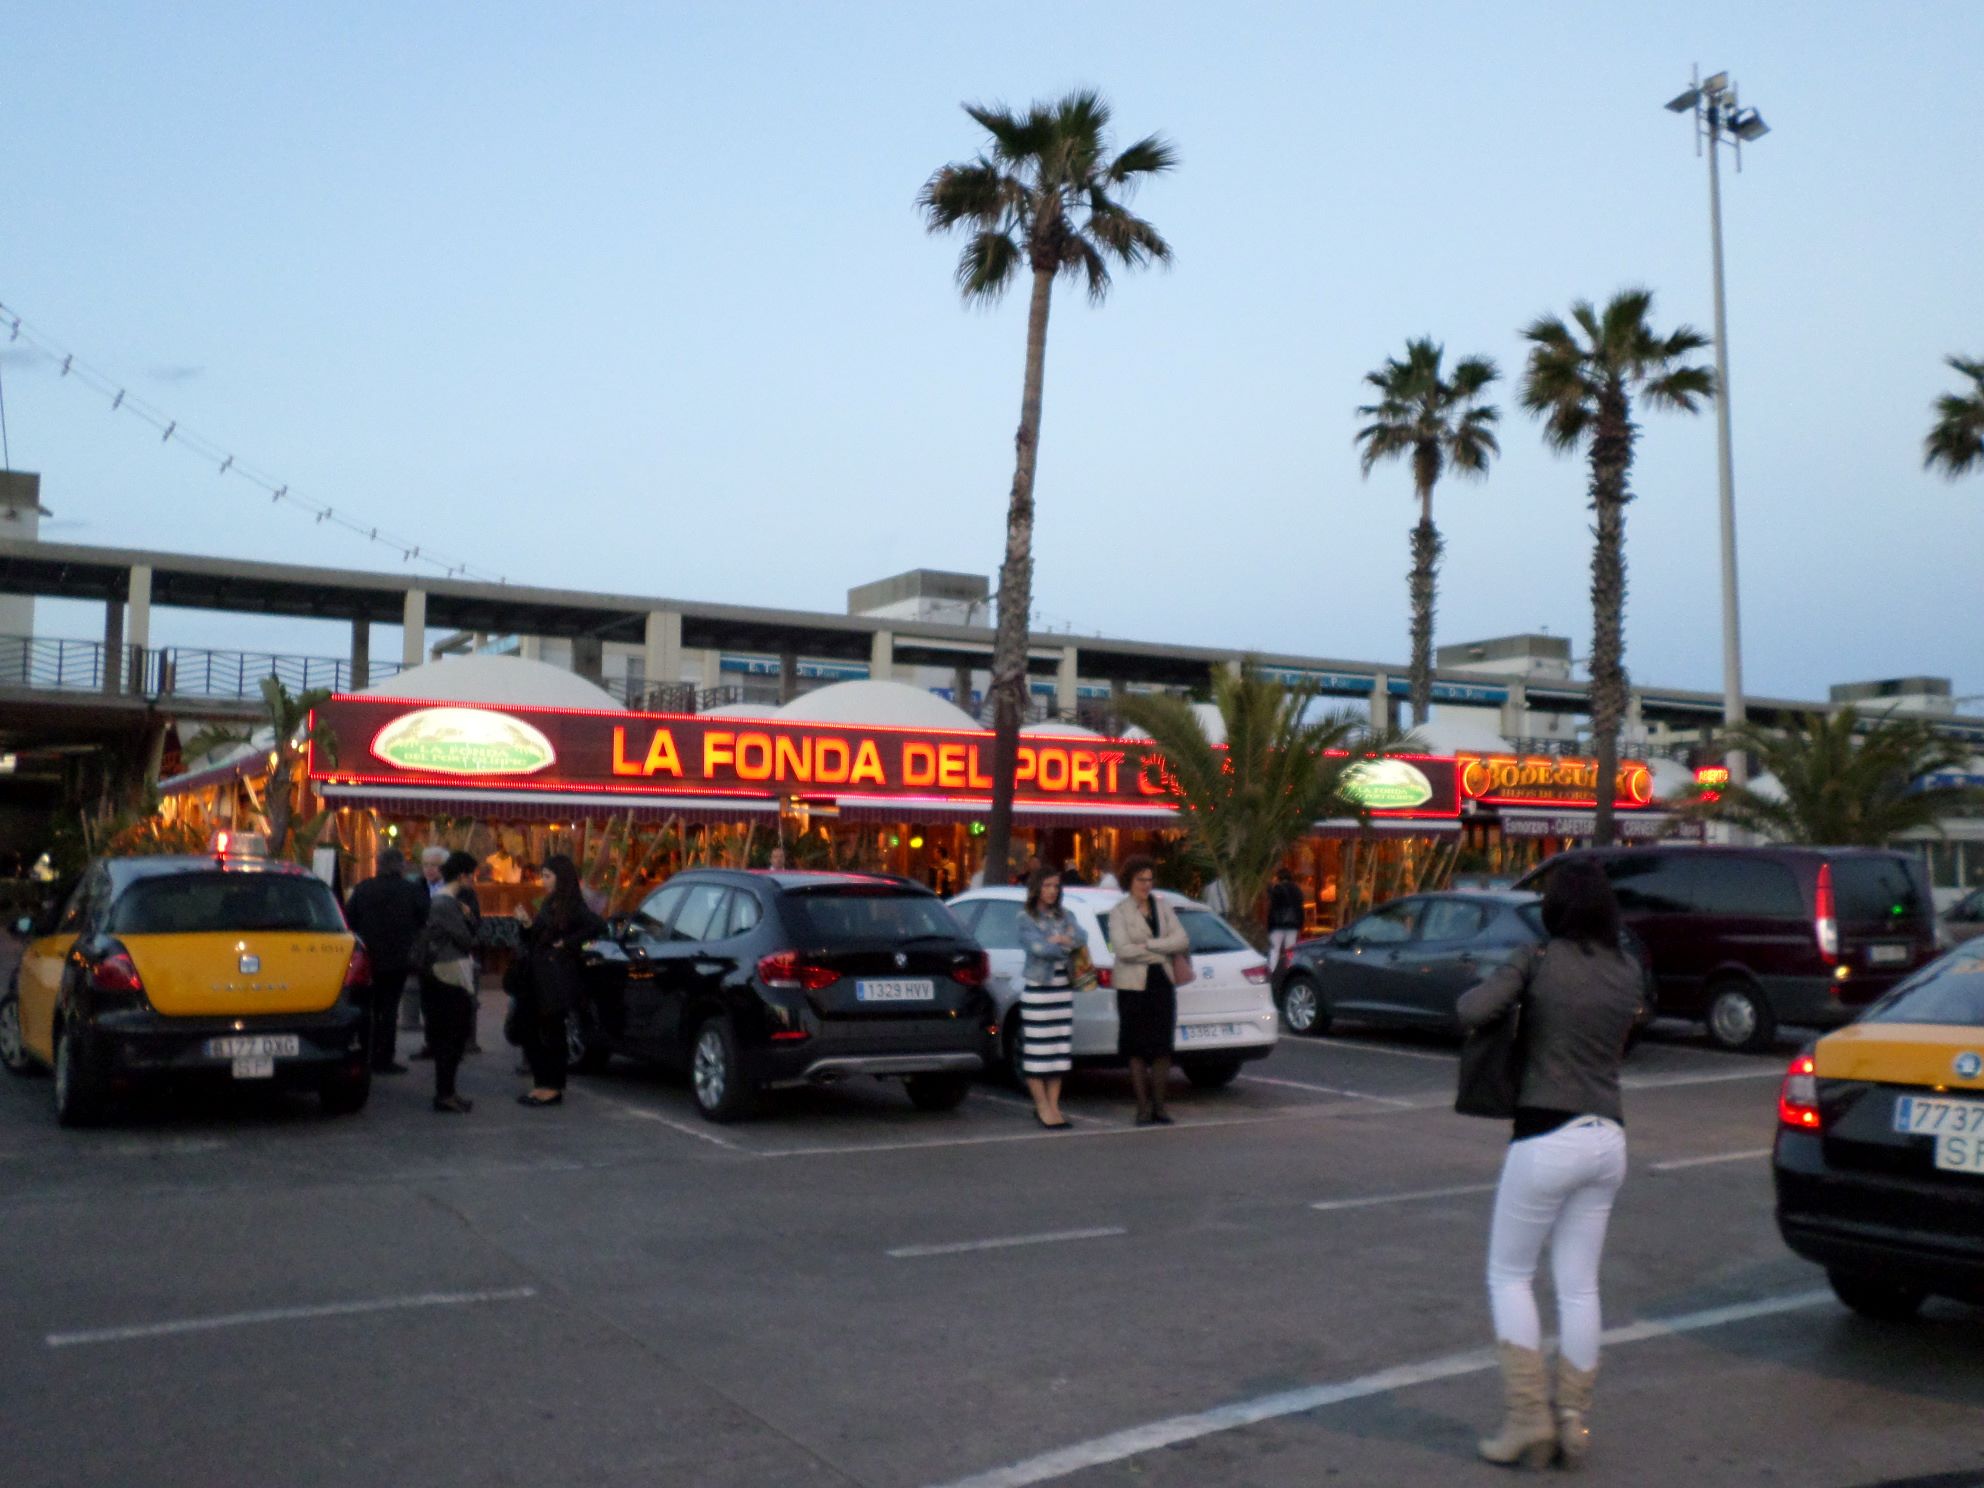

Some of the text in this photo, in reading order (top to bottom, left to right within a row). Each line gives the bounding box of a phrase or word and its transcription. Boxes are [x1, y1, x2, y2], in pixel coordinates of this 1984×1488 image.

[612, 725, 683, 777] LA
[703, 731, 886, 785] FONDA
[902, 742, 994, 789] DEL
[1014, 746, 1126, 794] PORT
[869, 983, 930, 998] 1329 HVV
